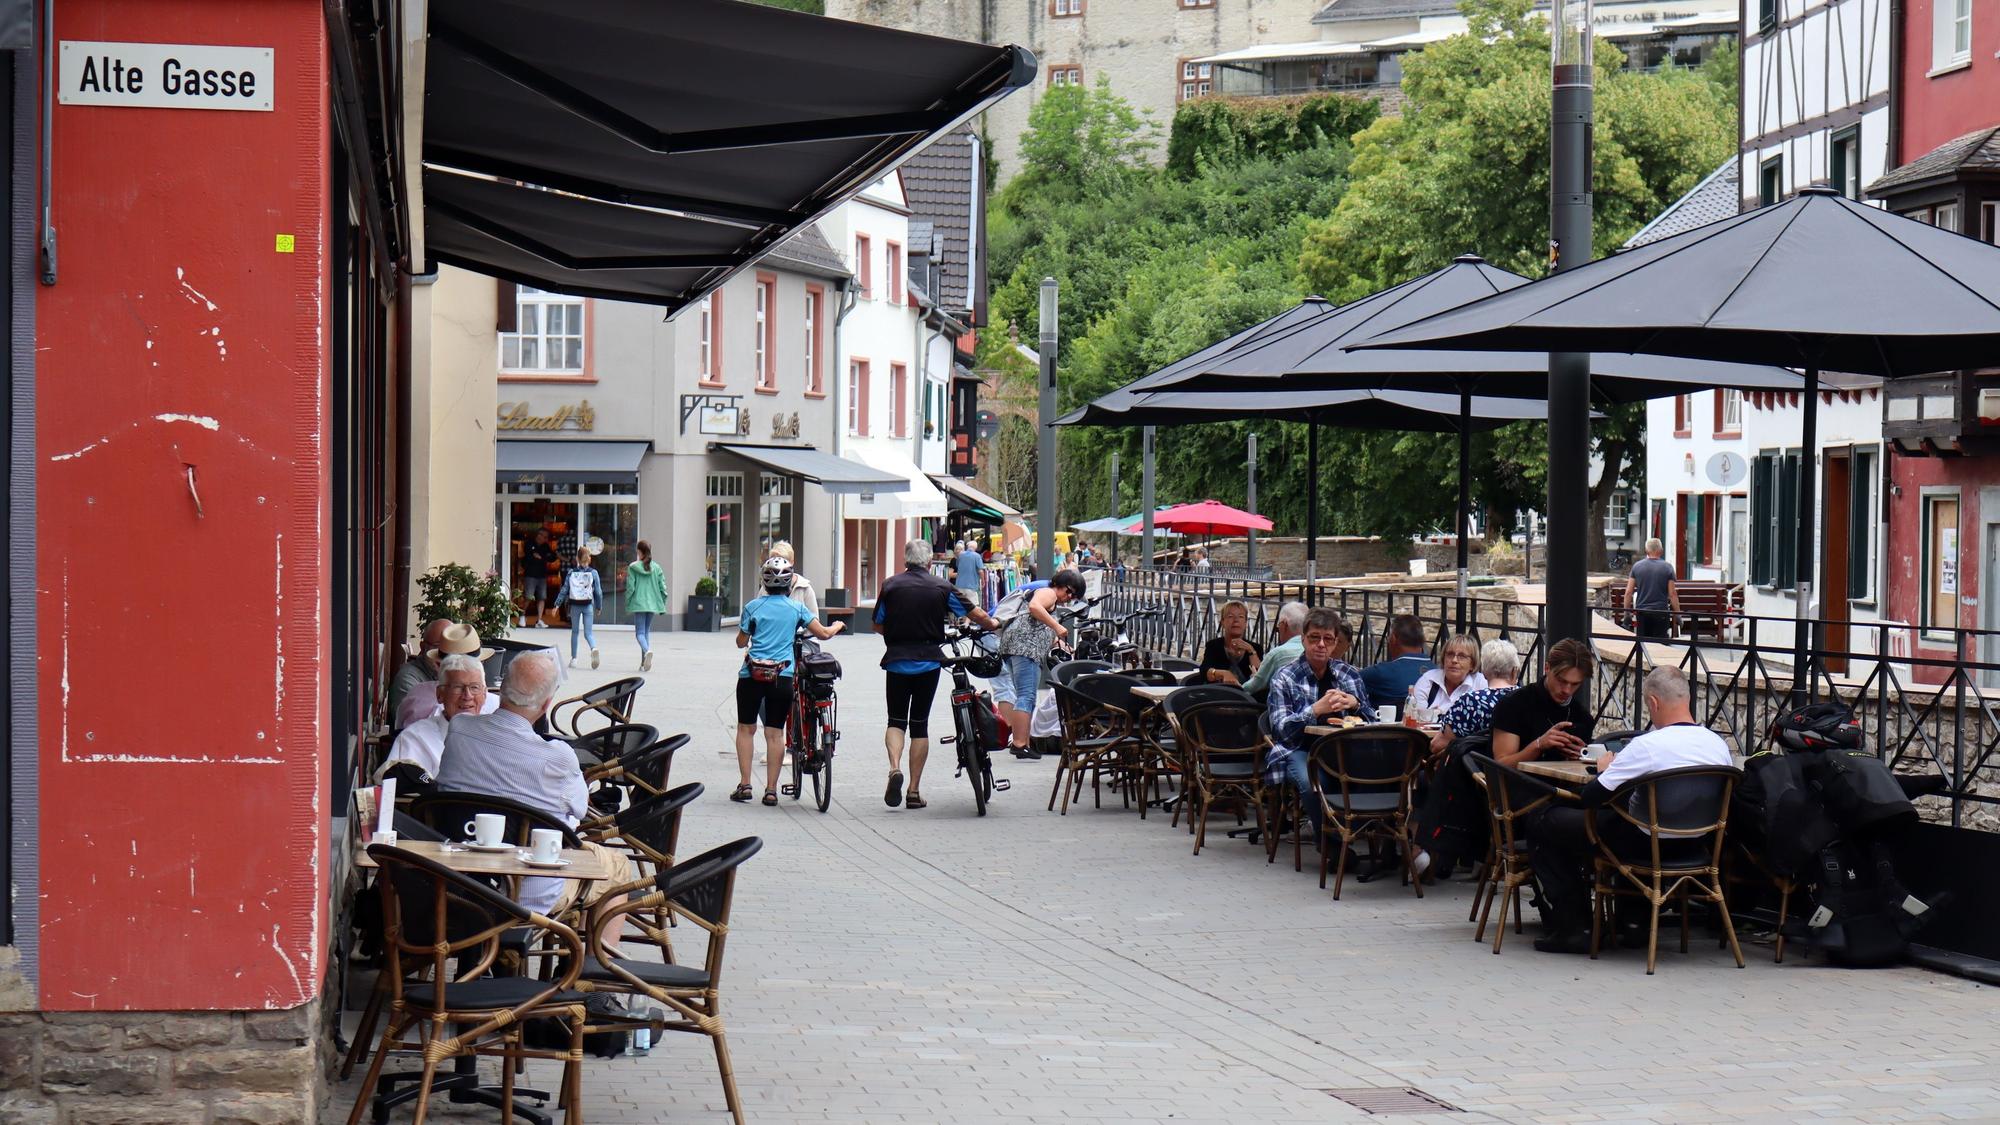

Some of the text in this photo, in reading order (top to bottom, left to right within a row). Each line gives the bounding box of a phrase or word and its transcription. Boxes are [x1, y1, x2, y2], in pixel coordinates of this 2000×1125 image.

[1593, 14, 1619, 24] ANT
[80, 56, 255, 97] Alte Gasse
[497, 402, 575, 431] Lindt
